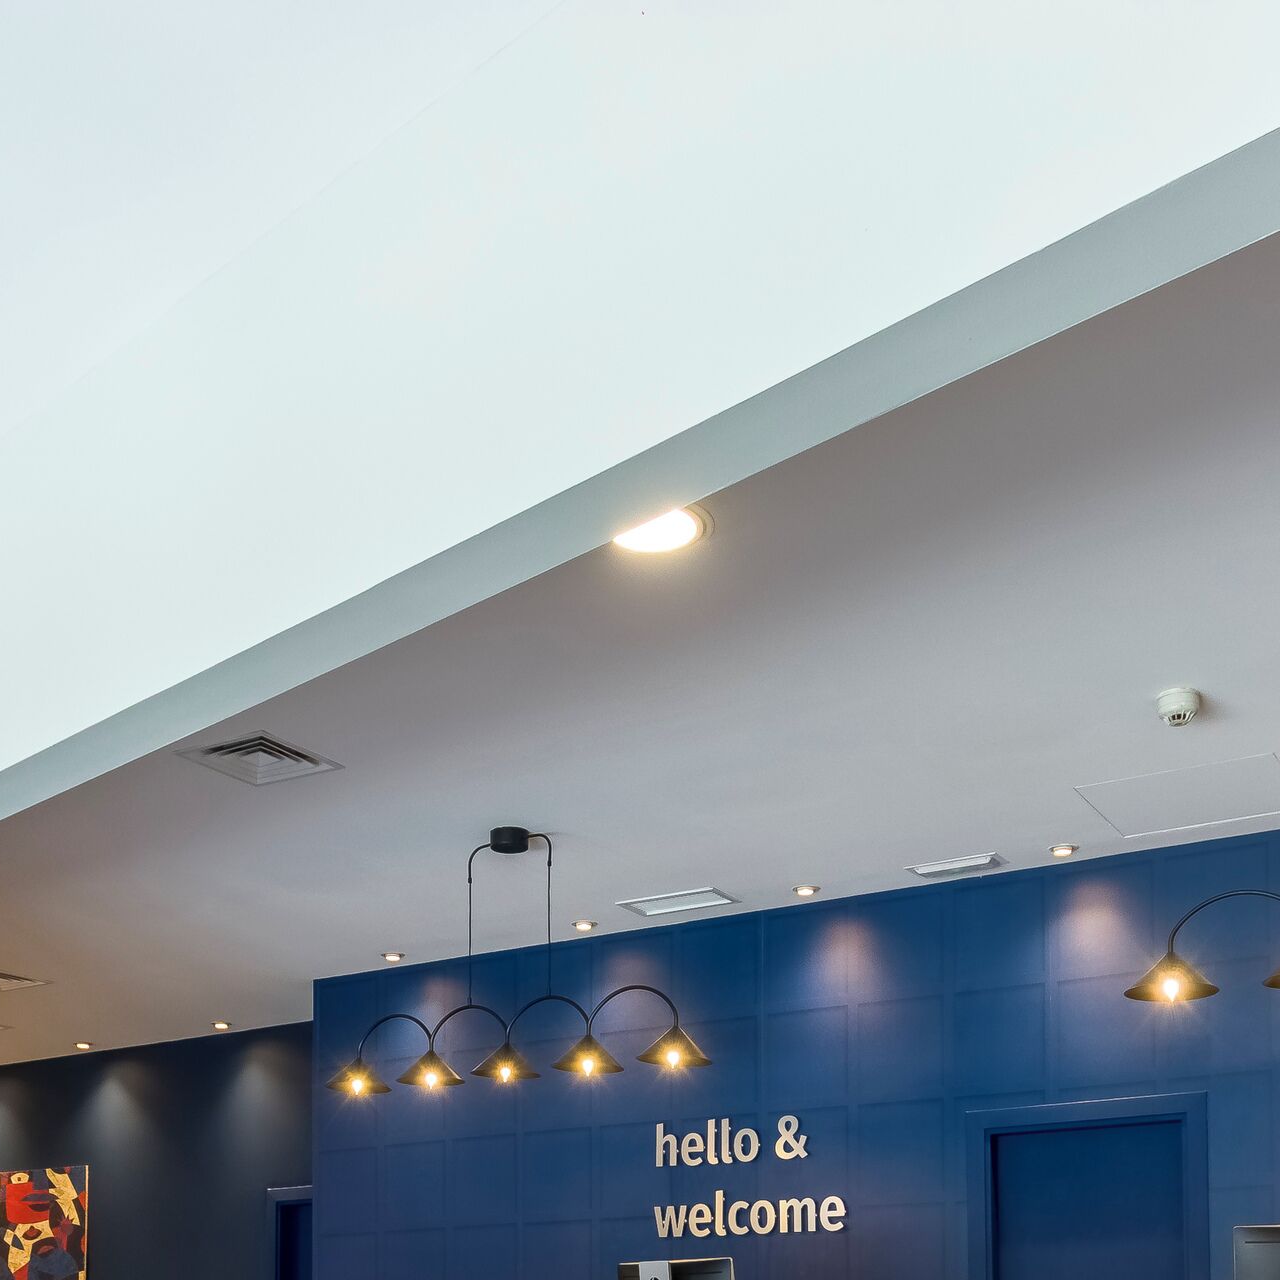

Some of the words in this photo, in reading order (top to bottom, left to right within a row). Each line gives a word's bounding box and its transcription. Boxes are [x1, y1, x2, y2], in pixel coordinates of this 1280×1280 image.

[655, 1117, 761, 1168] hello
[774, 1114, 809, 1160] &
[654, 1189, 846, 1239] welcome
